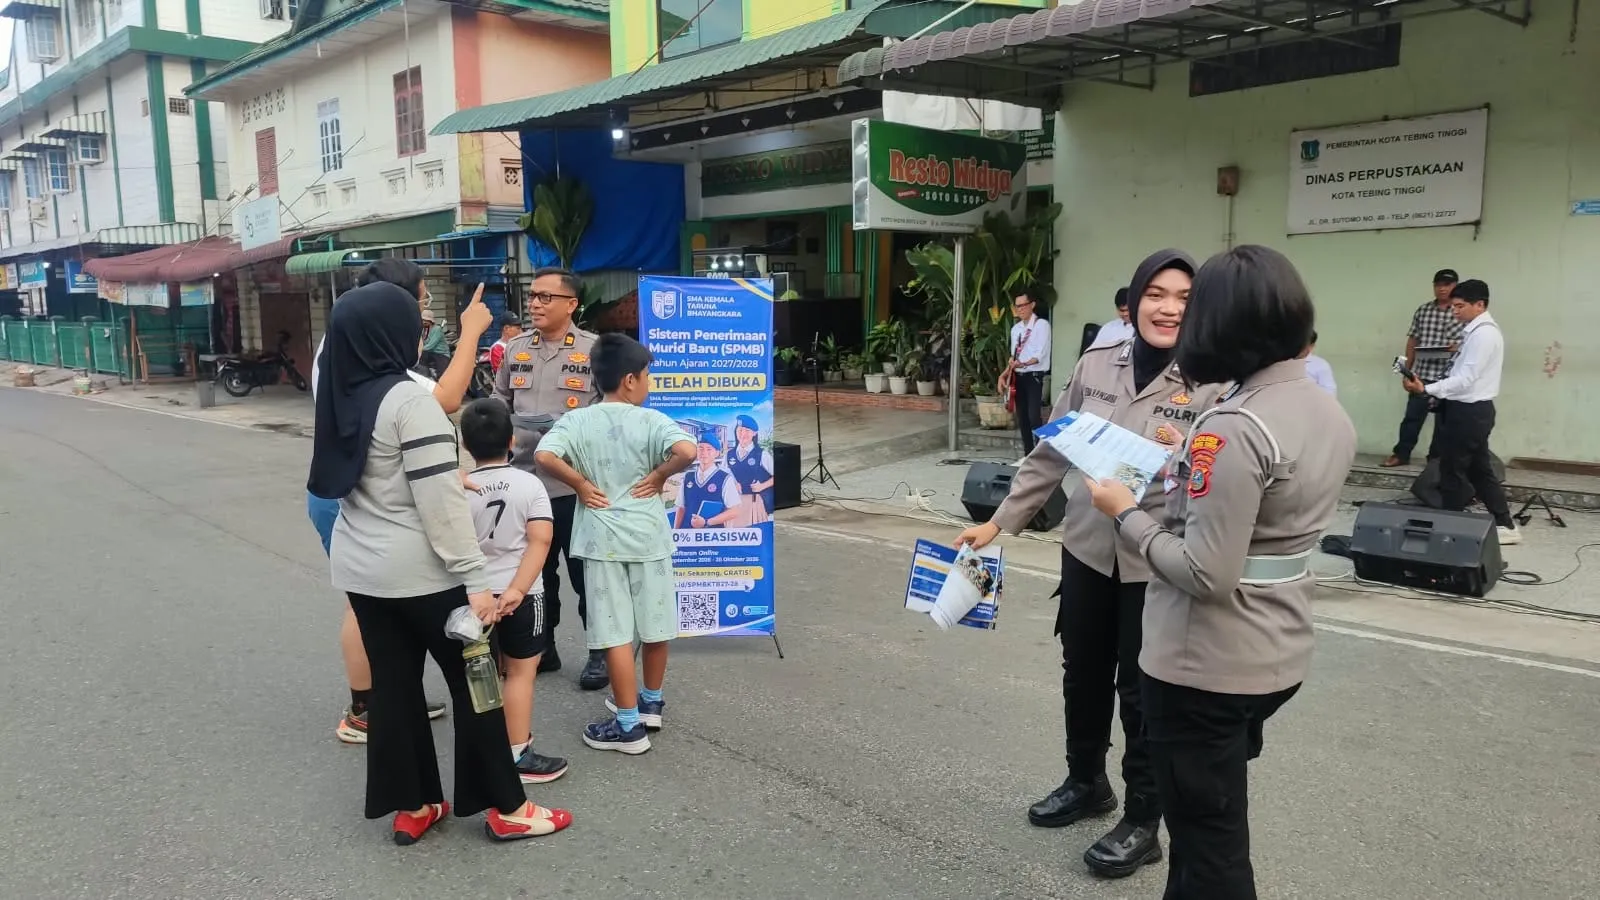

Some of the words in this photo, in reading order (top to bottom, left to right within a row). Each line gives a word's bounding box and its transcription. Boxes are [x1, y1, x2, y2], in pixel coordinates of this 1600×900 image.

[1326, 138, 1376, 150] PEMERINTAH
[1378, 135, 1400, 144] KOTA
[1404, 131, 1434, 142] TEBING
[1438, 128, 1467, 138] TINGGI
[889, 149, 950, 188] Resto
[952, 156, 1012, 200] Widya
[1306, 172, 1345, 186] DINAS
[1349, 161, 1464, 182] PERPUSTAKAAN
[925, 191, 950, 202] SOTO
[962, 195, 980, 204] SOP
[1332, 192, 1355, 200] KOTA
[1358, 188, 1391, 198] TEBING
[1394, 186, 1425, 196] TINGGI
[648, 328, 691, 340] Sistem
[694, 328, 766, 340] Penerimaan
[649, 342, 685, 354] Murid
[689, 343, 718, 354] Baru
[721, 344, 764, 356] (SPMB)
[562, 364, 590, 374] POLRI
[680, 359, 709, 368] Ajaran
[711, 359, 758, 368] 2027/2028
[653, 376, 702, 388] TELAH
[708, 376, 760, 388] DIBUKA
[1153, 404, 1198, 423] POLRI
[486, 500, 506, 539] 7
[672, 532, 691, 542] 0%
[695, 532, 758, 542] BEASISWA
